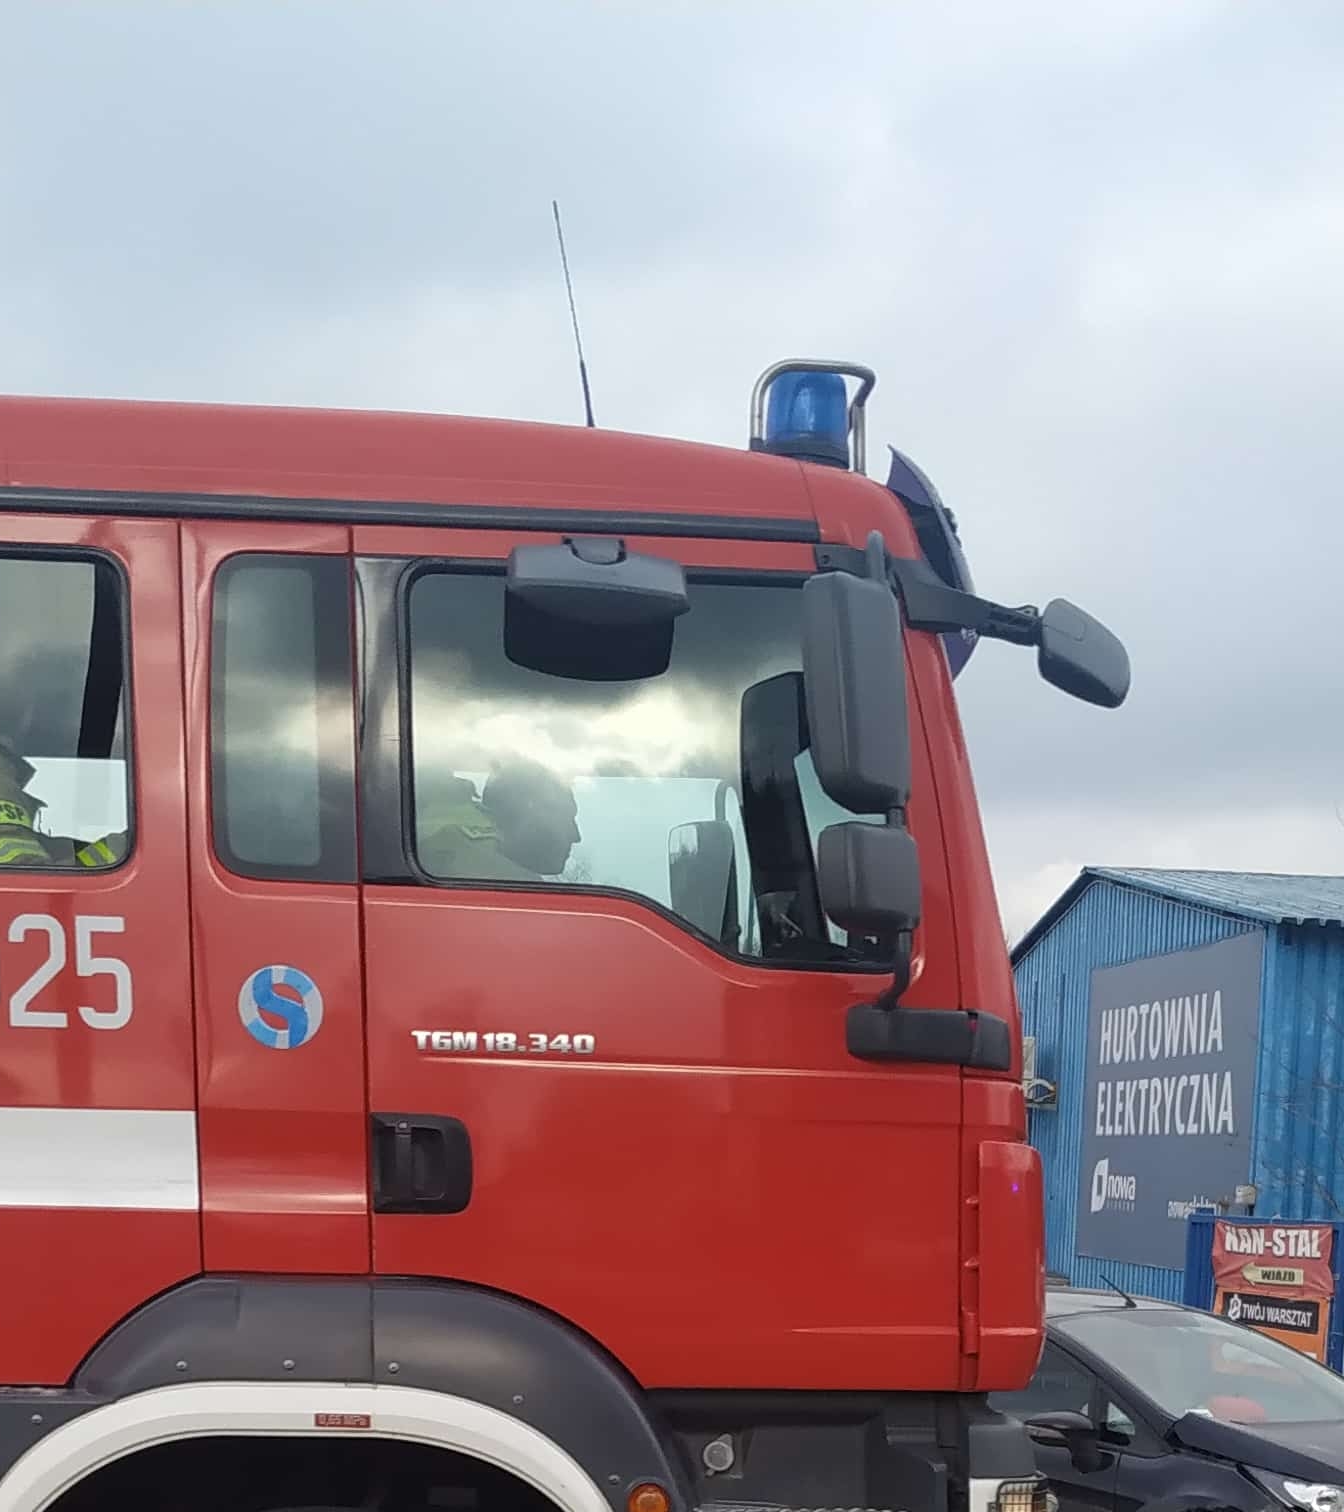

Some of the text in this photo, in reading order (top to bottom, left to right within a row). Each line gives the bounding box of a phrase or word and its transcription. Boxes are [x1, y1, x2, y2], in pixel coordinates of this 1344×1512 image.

[7, 913, 134, 1030] 25
[411, 1030, 596, 1054] TGM 18.340
[1099, 990, 1223, 1065] HURTOWNIA
[1095, 1071, 1233, 1136] ELEKTRYCZNA
[1108, 1175, 1136, 1200] nowa
[1242, 1302, 1313, 1328] TWÓJ WARSZTAT
